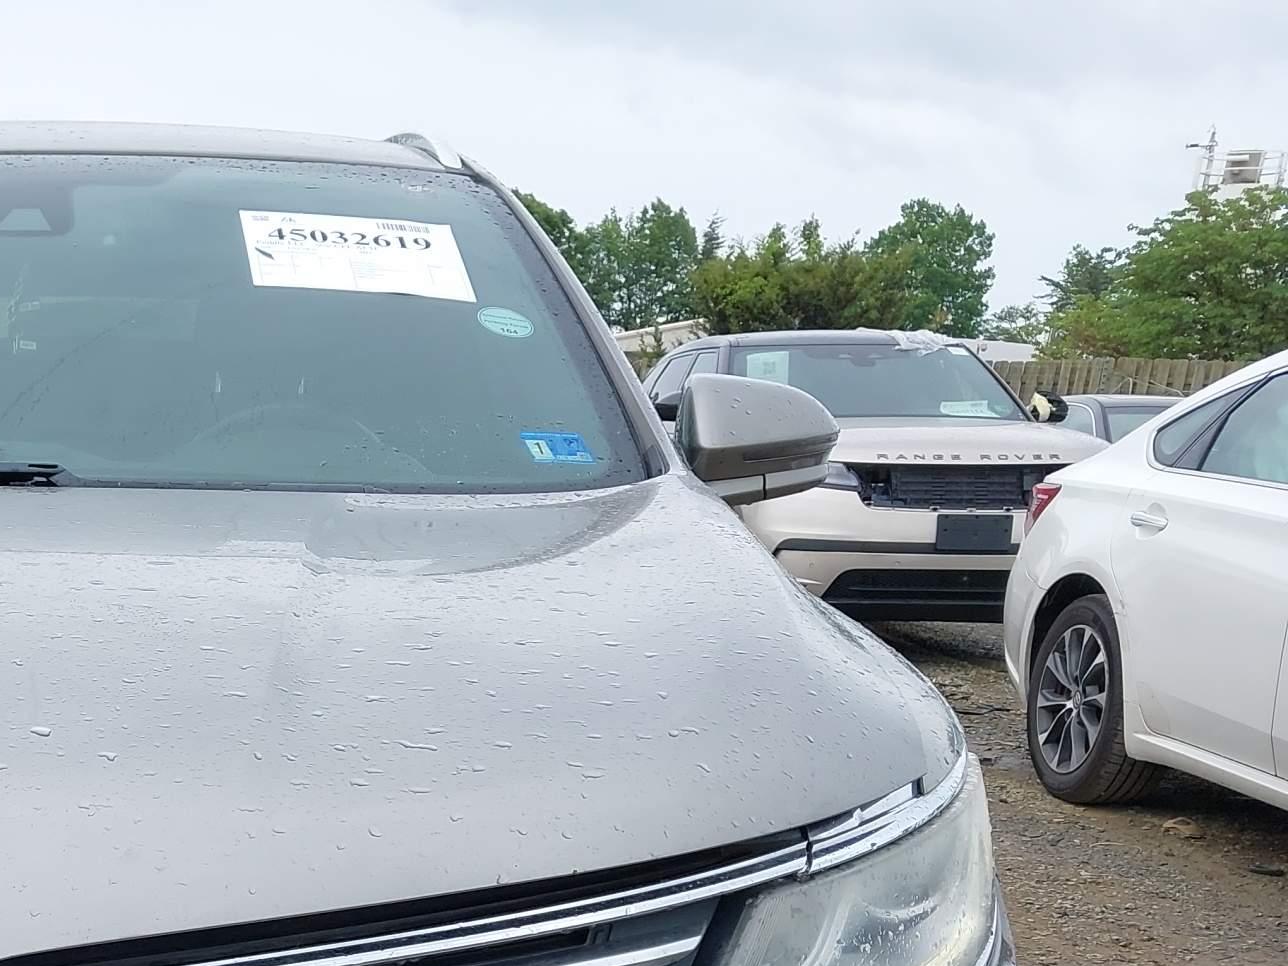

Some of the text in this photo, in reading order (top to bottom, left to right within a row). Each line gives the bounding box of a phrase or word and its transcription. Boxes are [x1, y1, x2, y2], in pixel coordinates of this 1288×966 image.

[267, 227, 432, 251] 45032619
[534, 441, 545, 456] 1
[876, 453, 1062, 461] RANGE ROVER
